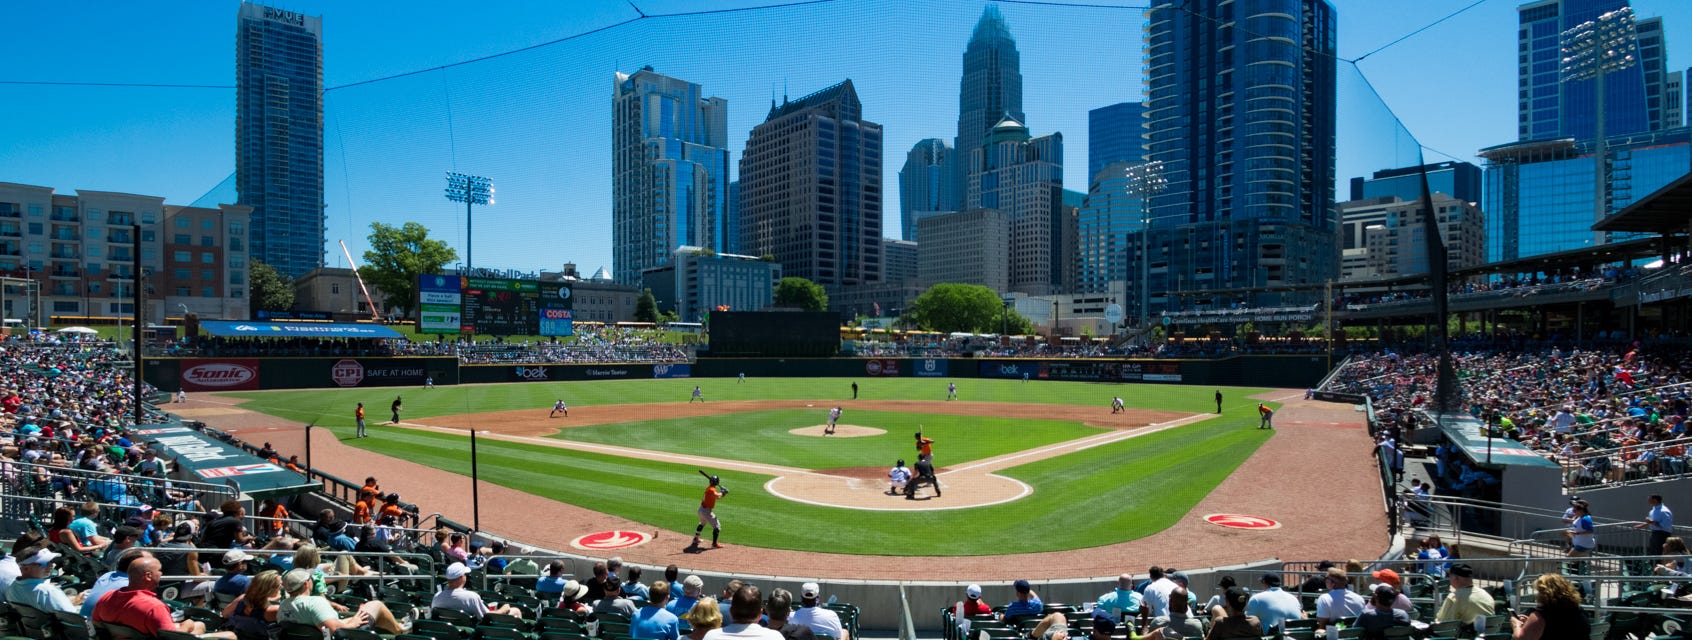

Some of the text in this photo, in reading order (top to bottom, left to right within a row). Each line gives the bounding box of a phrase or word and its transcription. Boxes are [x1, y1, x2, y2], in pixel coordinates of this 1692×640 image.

[275, 9, 302, 21] VUE
[546, 309, 571, 319] COSTA
[189, 367, 246, 379] Sonic
[335, 368, 361, 378] CPI
[367, 368, 425, 377] SAFE AT HOME
[522, 366, 548, 378] belk
[1001, 364, 1018, 374] belk
